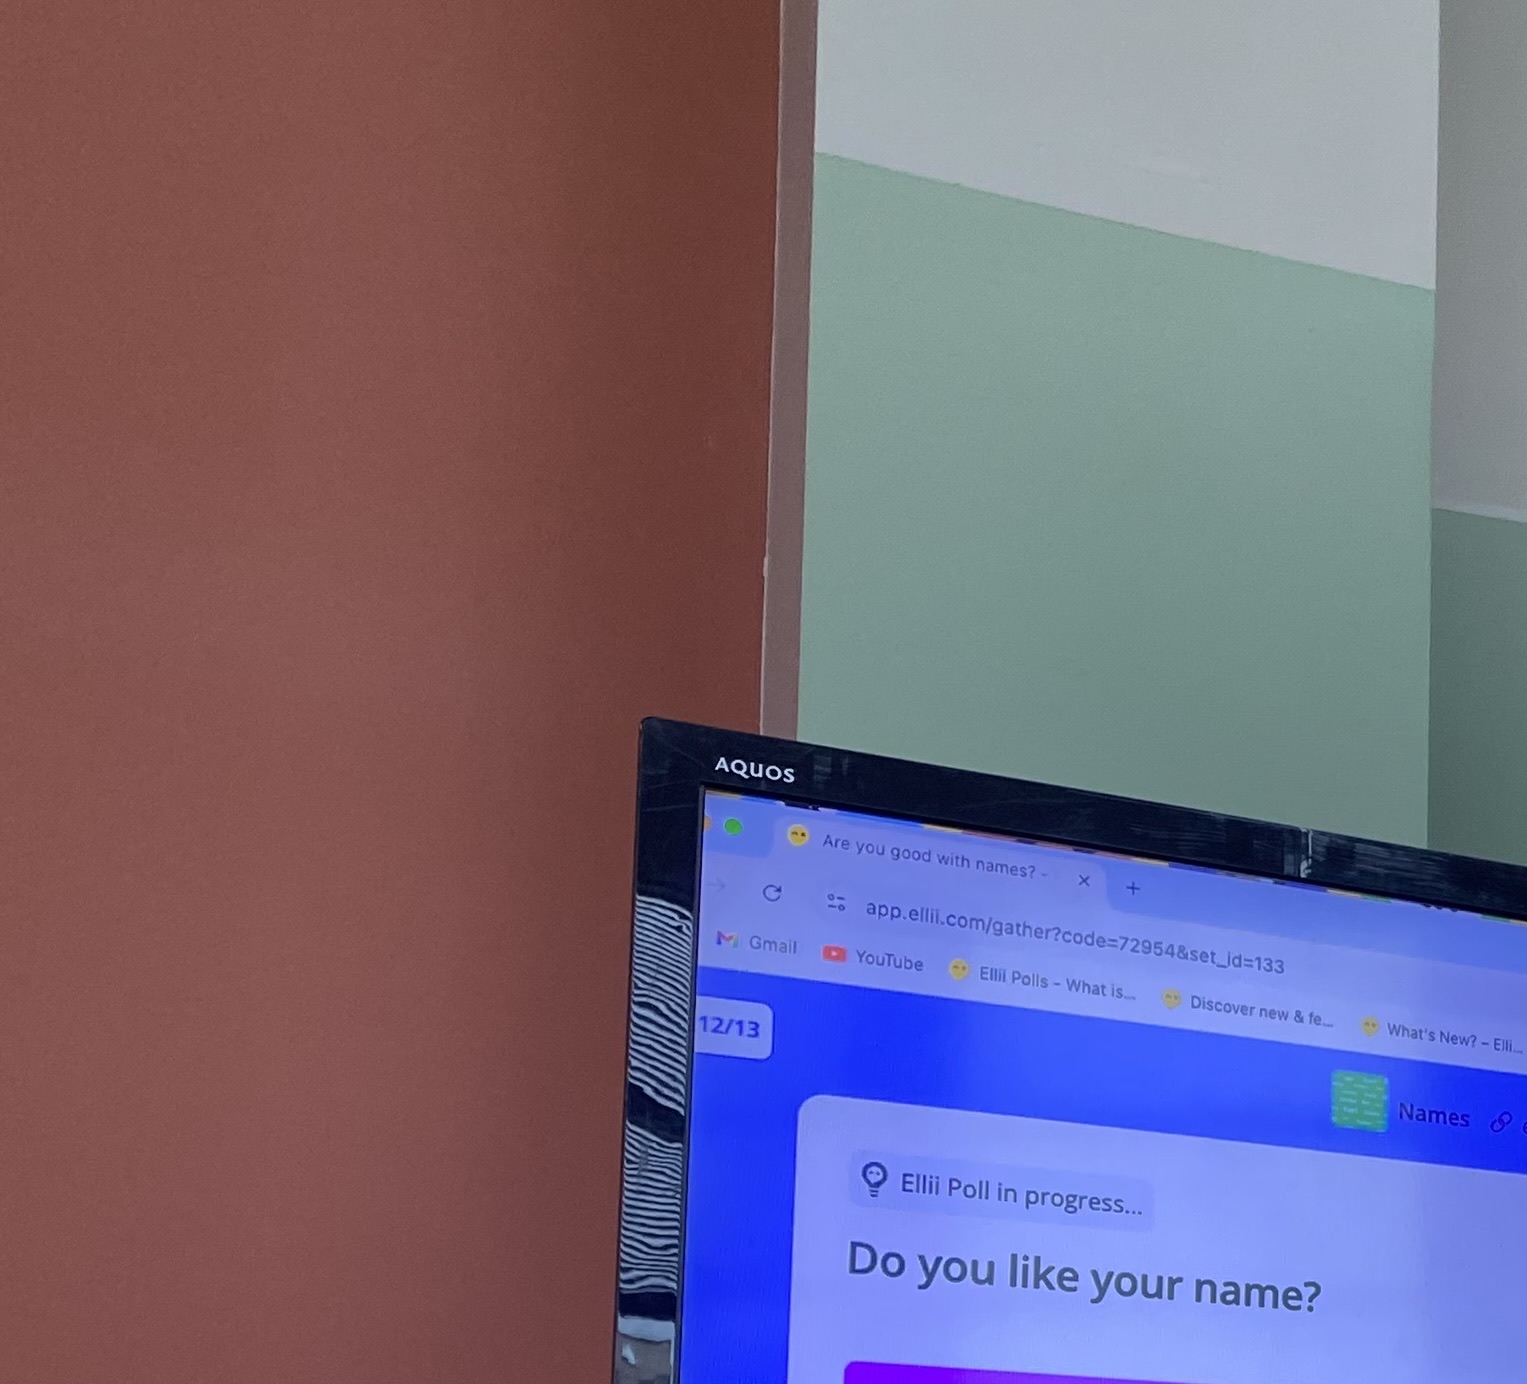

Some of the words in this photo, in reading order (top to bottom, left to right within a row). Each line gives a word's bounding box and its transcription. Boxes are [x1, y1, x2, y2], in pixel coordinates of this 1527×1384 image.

[715, 756, 796, 784] AQUOS
[822, 833, 850, 852] Are
[855, 839, 885, 859] you
[891, 843, 932, 865] good
[937, 850, 971, 870] with
[976, 859, 1036, 879] names?
[748, 934, 797, 956] Gmail
[866, 902, 1286, 975] app.ellii.com/gather?code=72954&set_id=133
[855, 948, 925, 972] YouTube
[979, 965, 1006, 984] Ellii
[1011, 970, 1049, 989] Polls
[1065, 976, 1107, 997] What
[1190, 995, 1255, 1018] Discover
[1259, 1005, 1289, 1021] new
[1293, 1009, 1305, 1024] &
[699, 1015, 760, 1038] 12/13
[1387, 1021, 1436, 1043] What's
[1439, 1028, 1477, 1048] New?
[1398, 1103, 1471, 1129] Names
[900, 1171, 940, 1197] Ellii
[946, 1175, 990, 1202] Poll
[997, 1181, 1018, 1204] in
[1024, 1187, 1143, 1216] progress...
[848, 1240, 906, 1278] Do
[917, 1250, 997, 1291] you
[1008, 1252, 1080, 1293] like
[1090, 1264, 1184, 1304] your
[1194, 1277, 1322, 1313] name?
